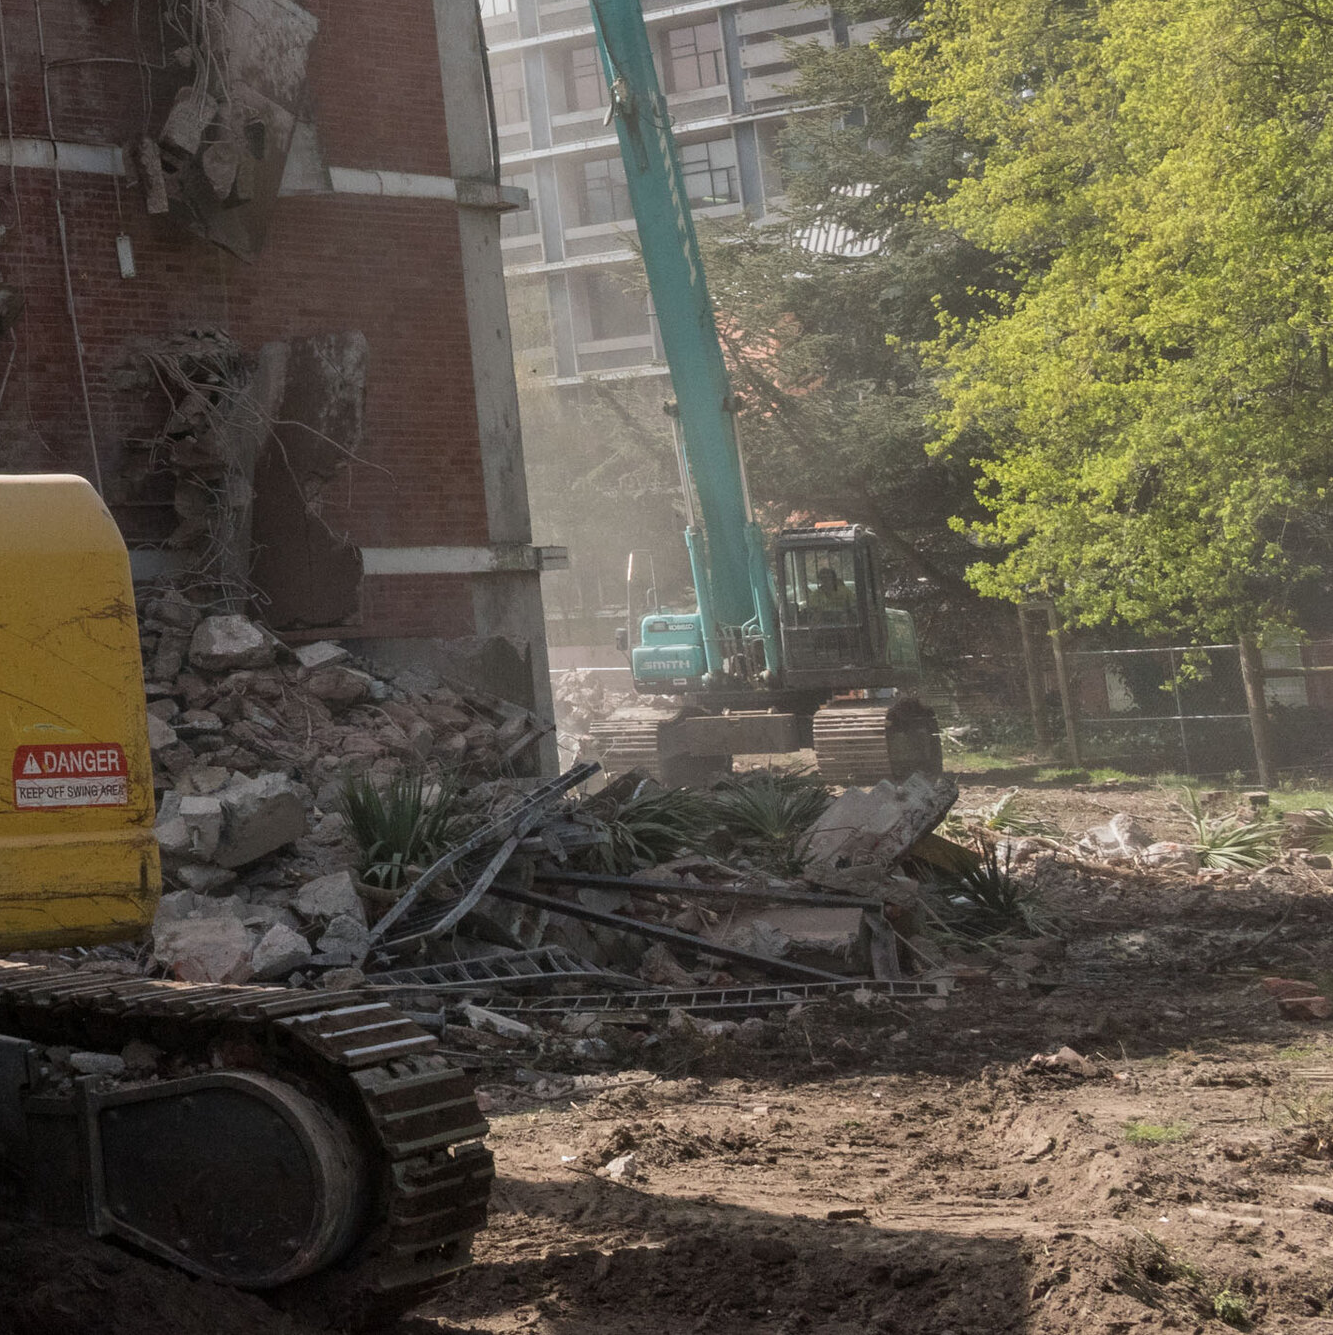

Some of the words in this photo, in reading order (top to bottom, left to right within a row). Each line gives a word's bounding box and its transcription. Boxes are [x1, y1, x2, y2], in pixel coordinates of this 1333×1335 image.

[44, 749, 120, 773] DANGER
[19, 786, 45, 799] KEEP
[46, 785, 65, 798] OFF
[67, 785, 98, 798] SWING
[101, 784, 124, 796] AREA
